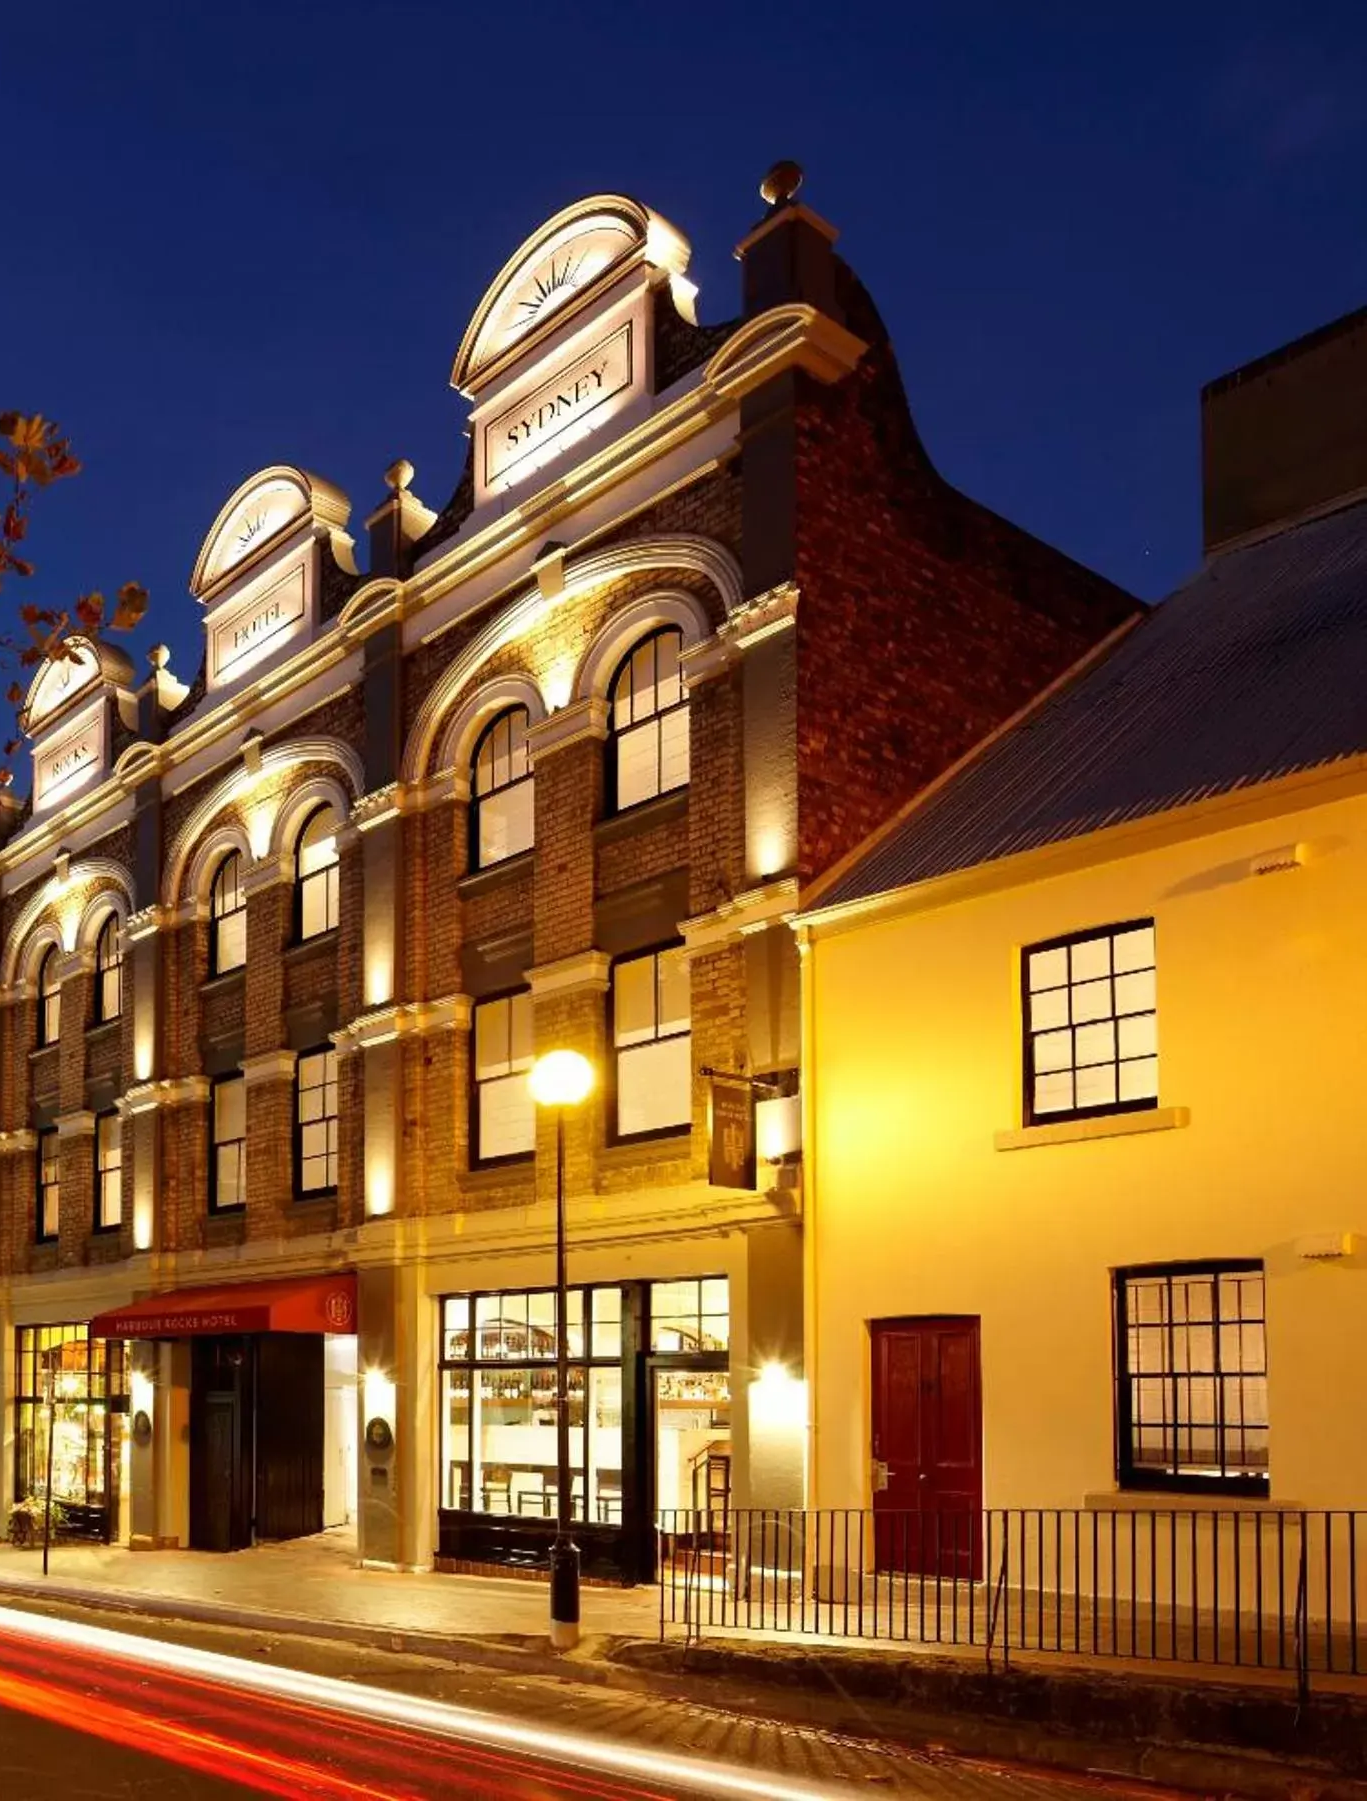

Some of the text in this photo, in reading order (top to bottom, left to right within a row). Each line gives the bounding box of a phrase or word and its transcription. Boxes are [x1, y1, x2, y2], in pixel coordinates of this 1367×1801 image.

[505, 360, 609, 452] SYDNEY
[115, 1313, 238, 1333] HARBOUR ROCKS HOTEL
